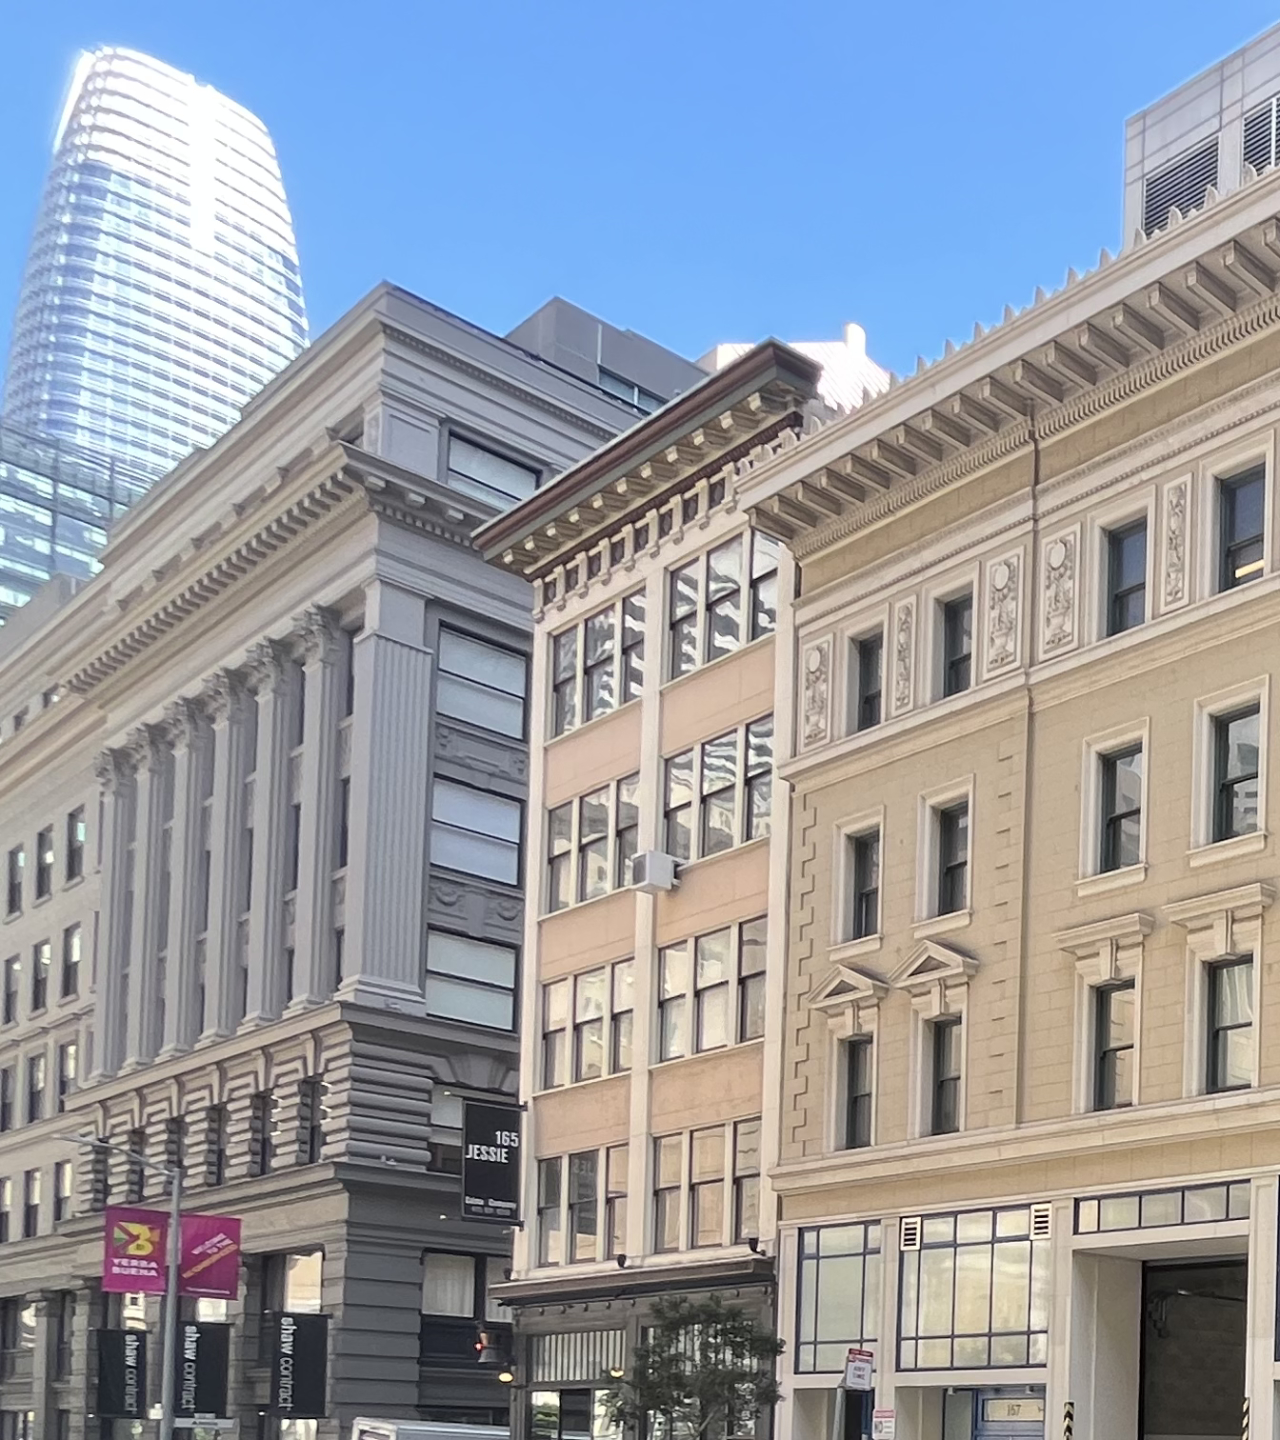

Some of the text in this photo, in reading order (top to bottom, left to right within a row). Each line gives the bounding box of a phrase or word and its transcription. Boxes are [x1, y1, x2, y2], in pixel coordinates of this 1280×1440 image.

[496, 1131, 519, 1147] 165
[465, 1144, 509, 1163] JESSIE
[111, 1266, 158, 1277] BUENA
[112, 1257, 159, 1269] YERBA
[181, 1325, 200, 1412] shaw contract
[278, 1317, 298, 1410] shaw contract
[124, 1334, 140, 1414] shaw contract
[1007, 1404, 1021, 1416] 157
